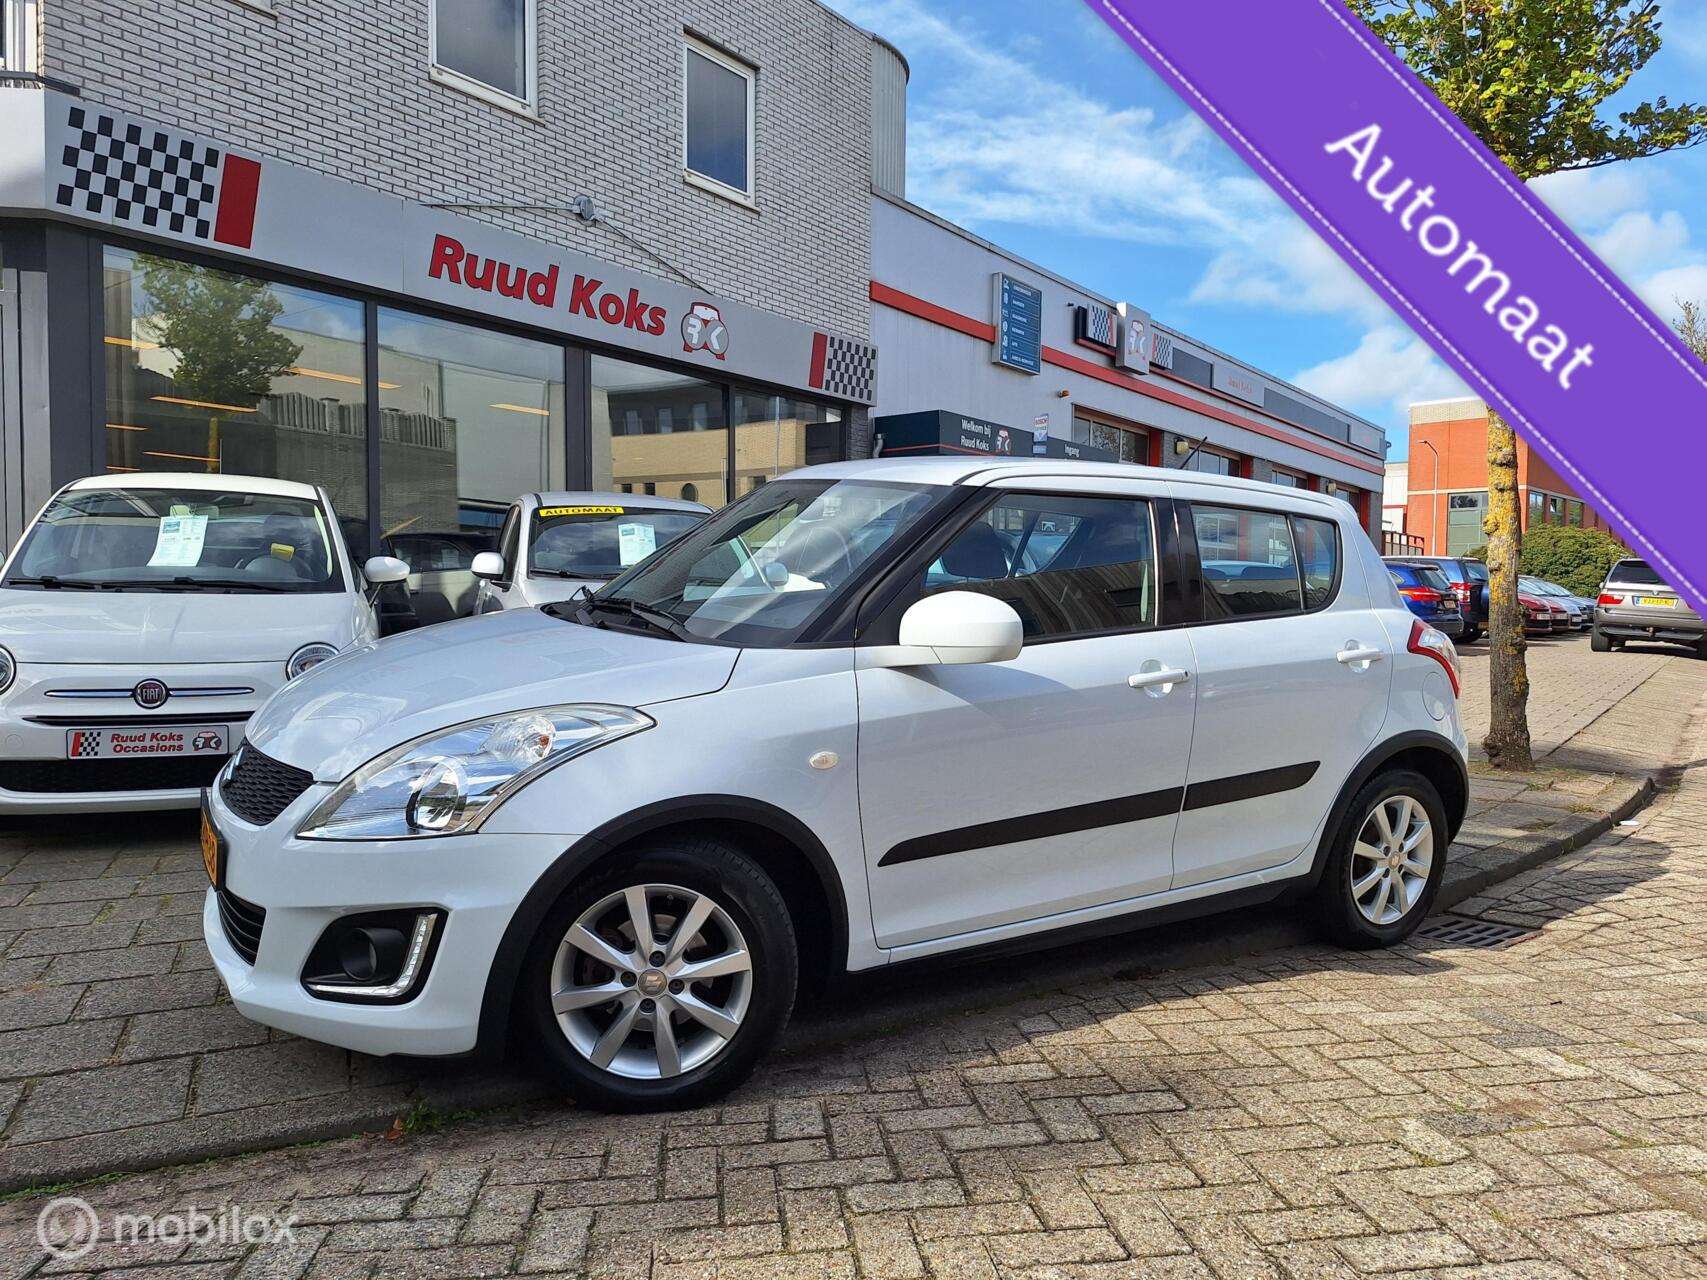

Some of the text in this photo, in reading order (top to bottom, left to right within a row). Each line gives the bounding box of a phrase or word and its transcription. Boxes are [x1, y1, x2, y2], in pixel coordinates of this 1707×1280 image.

[428, 234, 667, 337] Ruud Koks
[961, 418, 984, 434] Welkom
[960, 435, 989, 451] Ruud Koks
[545, 506, 619, 515] AUTOMAAT
[143, 688, 160, 700] FIAT
[111, 731, 184, 743] Ruud Koks
[113, 743, 184, 754] Occasions
